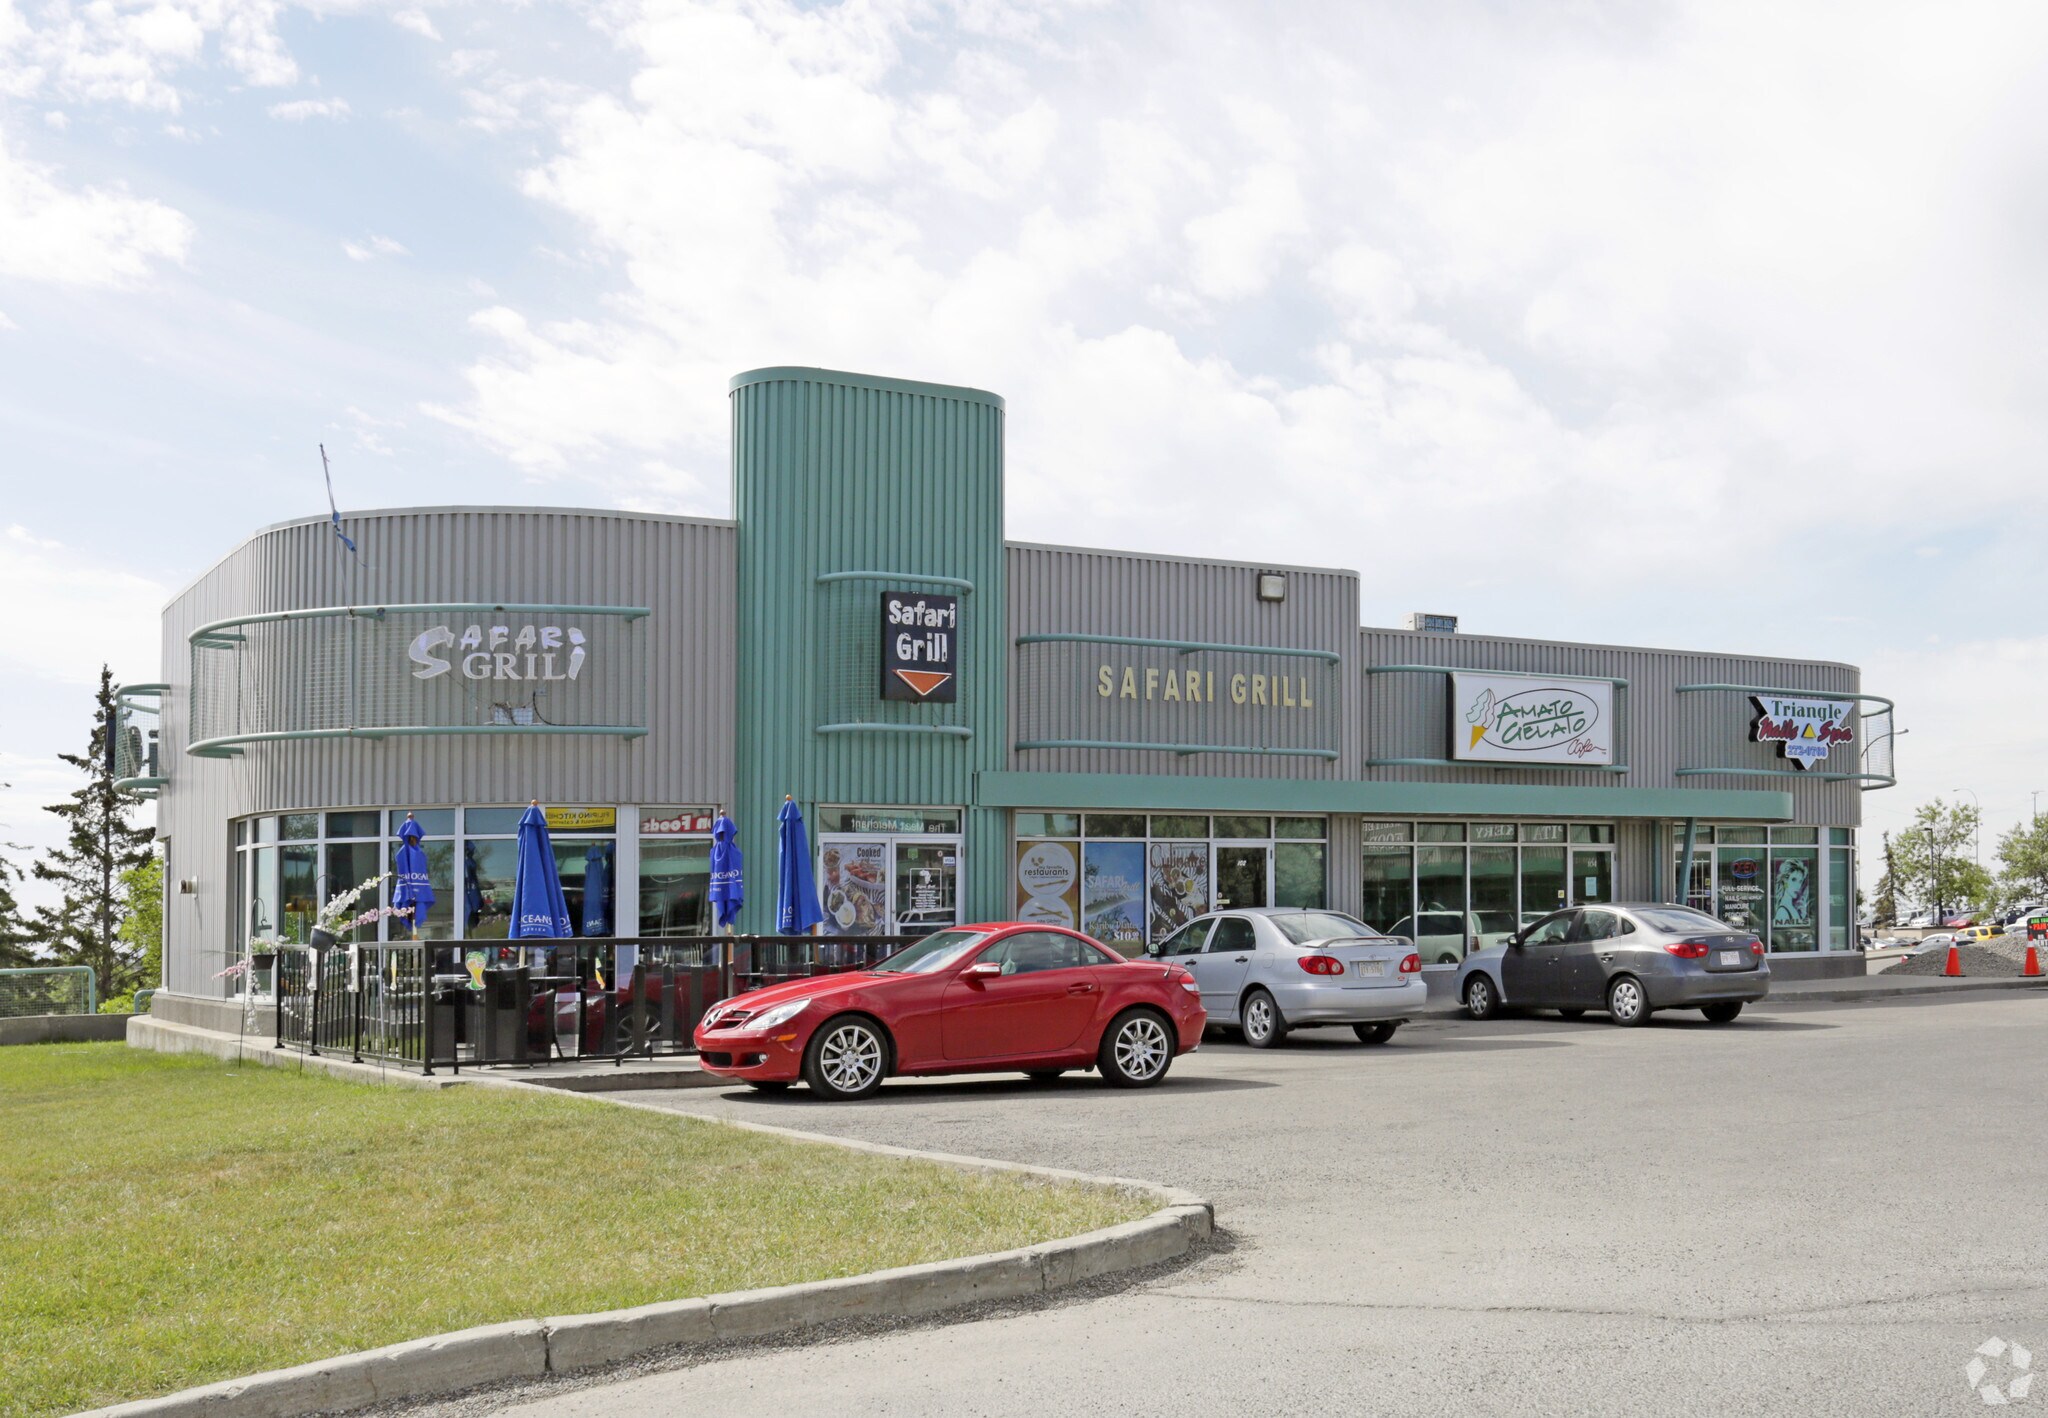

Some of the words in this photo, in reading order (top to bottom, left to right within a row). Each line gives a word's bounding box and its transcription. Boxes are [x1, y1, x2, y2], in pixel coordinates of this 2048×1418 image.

[889, 600, 956, 629] Safari
[896, 632, 948, 662] Grill
[1097, 665, 1214, 703] SAFARI
[1230, 673, 1313, 708] GRILL
[1495, 700, 1574, 732] AMATO
[1771, 700, 1842, 722] Triangle
[1501, 716, 1586, 745] GELATO
[1758, 716, 1800, 741] Nails
[1817, 720, 1853, 745] Spa
[857, 847, 881, 858] Cooked
[1024, 868, 1069, 876] restaurants
[1088, 875, 1125, 889] SAFARI
